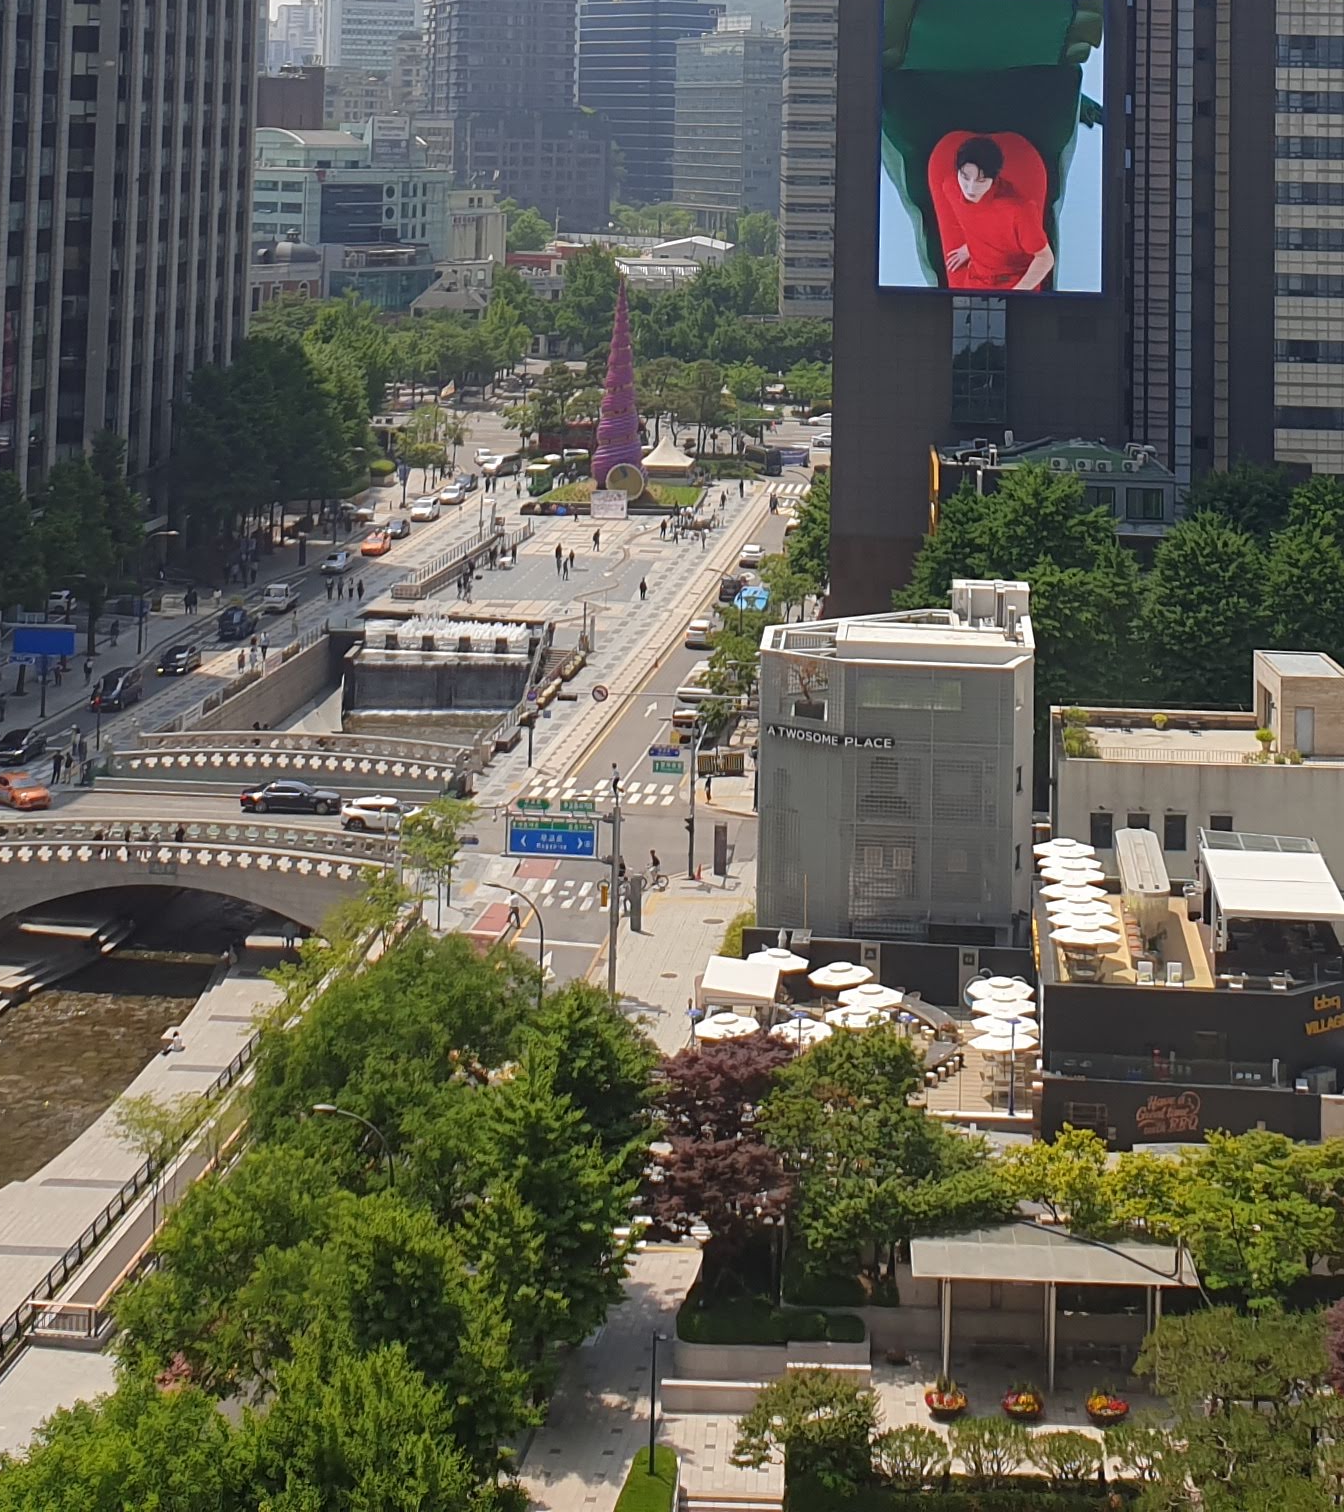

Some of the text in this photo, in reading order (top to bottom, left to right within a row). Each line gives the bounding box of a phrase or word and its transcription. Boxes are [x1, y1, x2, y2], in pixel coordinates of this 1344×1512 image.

[767, 725, 892, 749] A TWOSOME PLACE
[1313, 993, 1341, 1010] bbq
